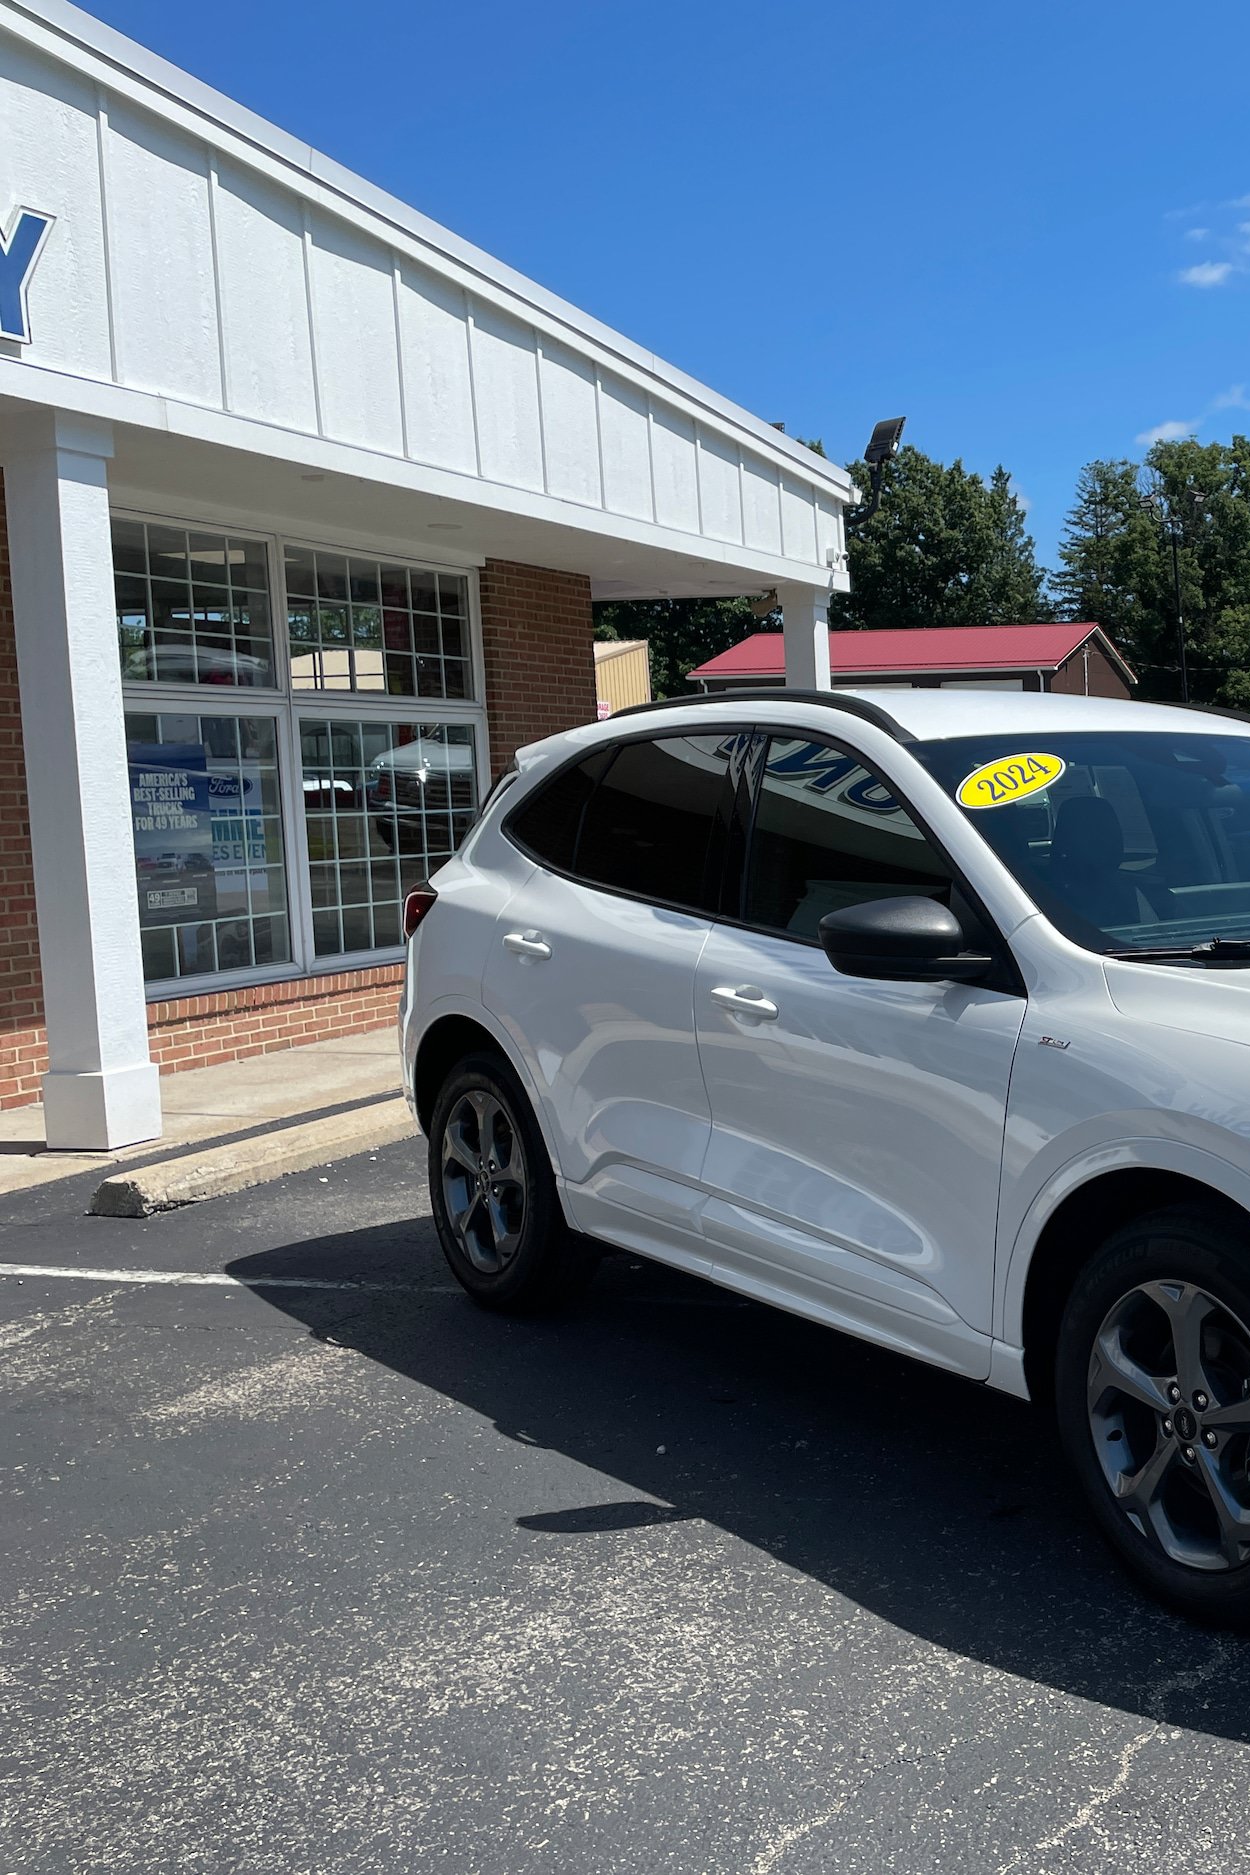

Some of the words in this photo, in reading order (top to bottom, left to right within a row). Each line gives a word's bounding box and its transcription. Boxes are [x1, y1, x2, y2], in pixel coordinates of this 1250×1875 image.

[139, 773, 188, 787] AMERICA'S
[977, 757, 1051, 801] 2024
[134, 786, 195, 802] BEST-SELLING
[147, 802, 183, 816] TRUCKS
[135, 817, 155, 831] FOR
[155, 816, 168, 830] 49
[168, 815, 198, 829] YEARS
